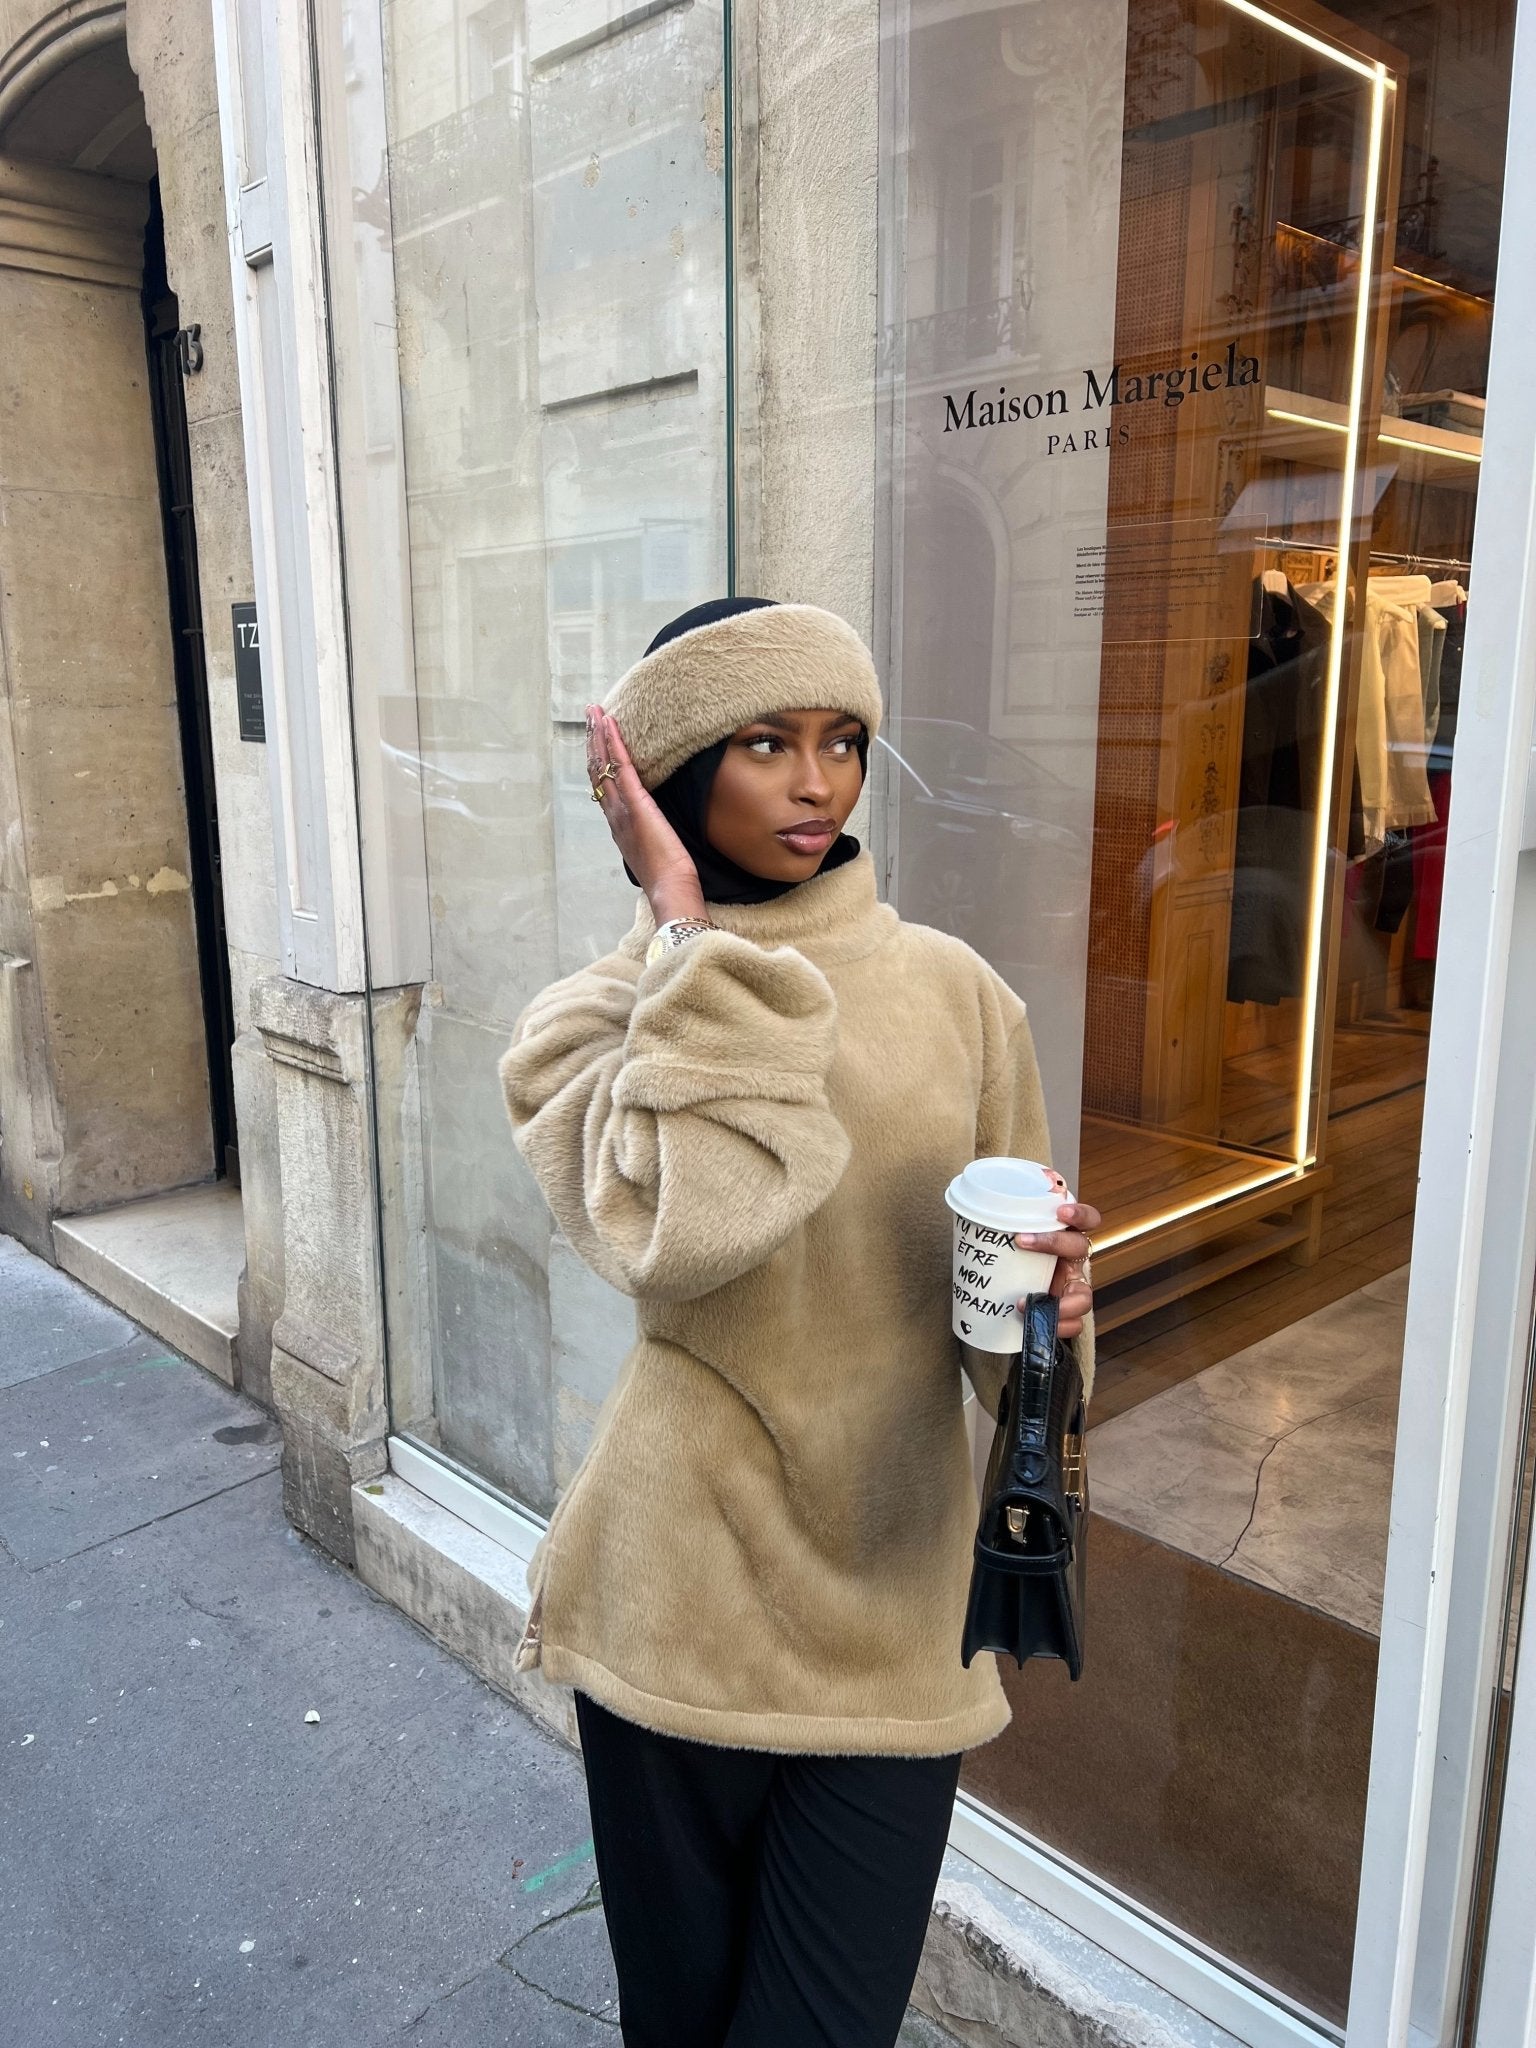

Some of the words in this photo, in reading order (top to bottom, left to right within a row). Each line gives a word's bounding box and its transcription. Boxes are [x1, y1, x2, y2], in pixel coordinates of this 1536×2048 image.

[943, 386, 1068, 432] Maison
[1082, 342, 1261, 409] Margiela
[1047, 424, 1129, 455] PARIS
[237, 622, 260, 648] TZ
[955, 1214, 970, 1235] TU
[975, 1226, 1016, 1252] VEUX
[958, 1265, 992, 1290] MON
